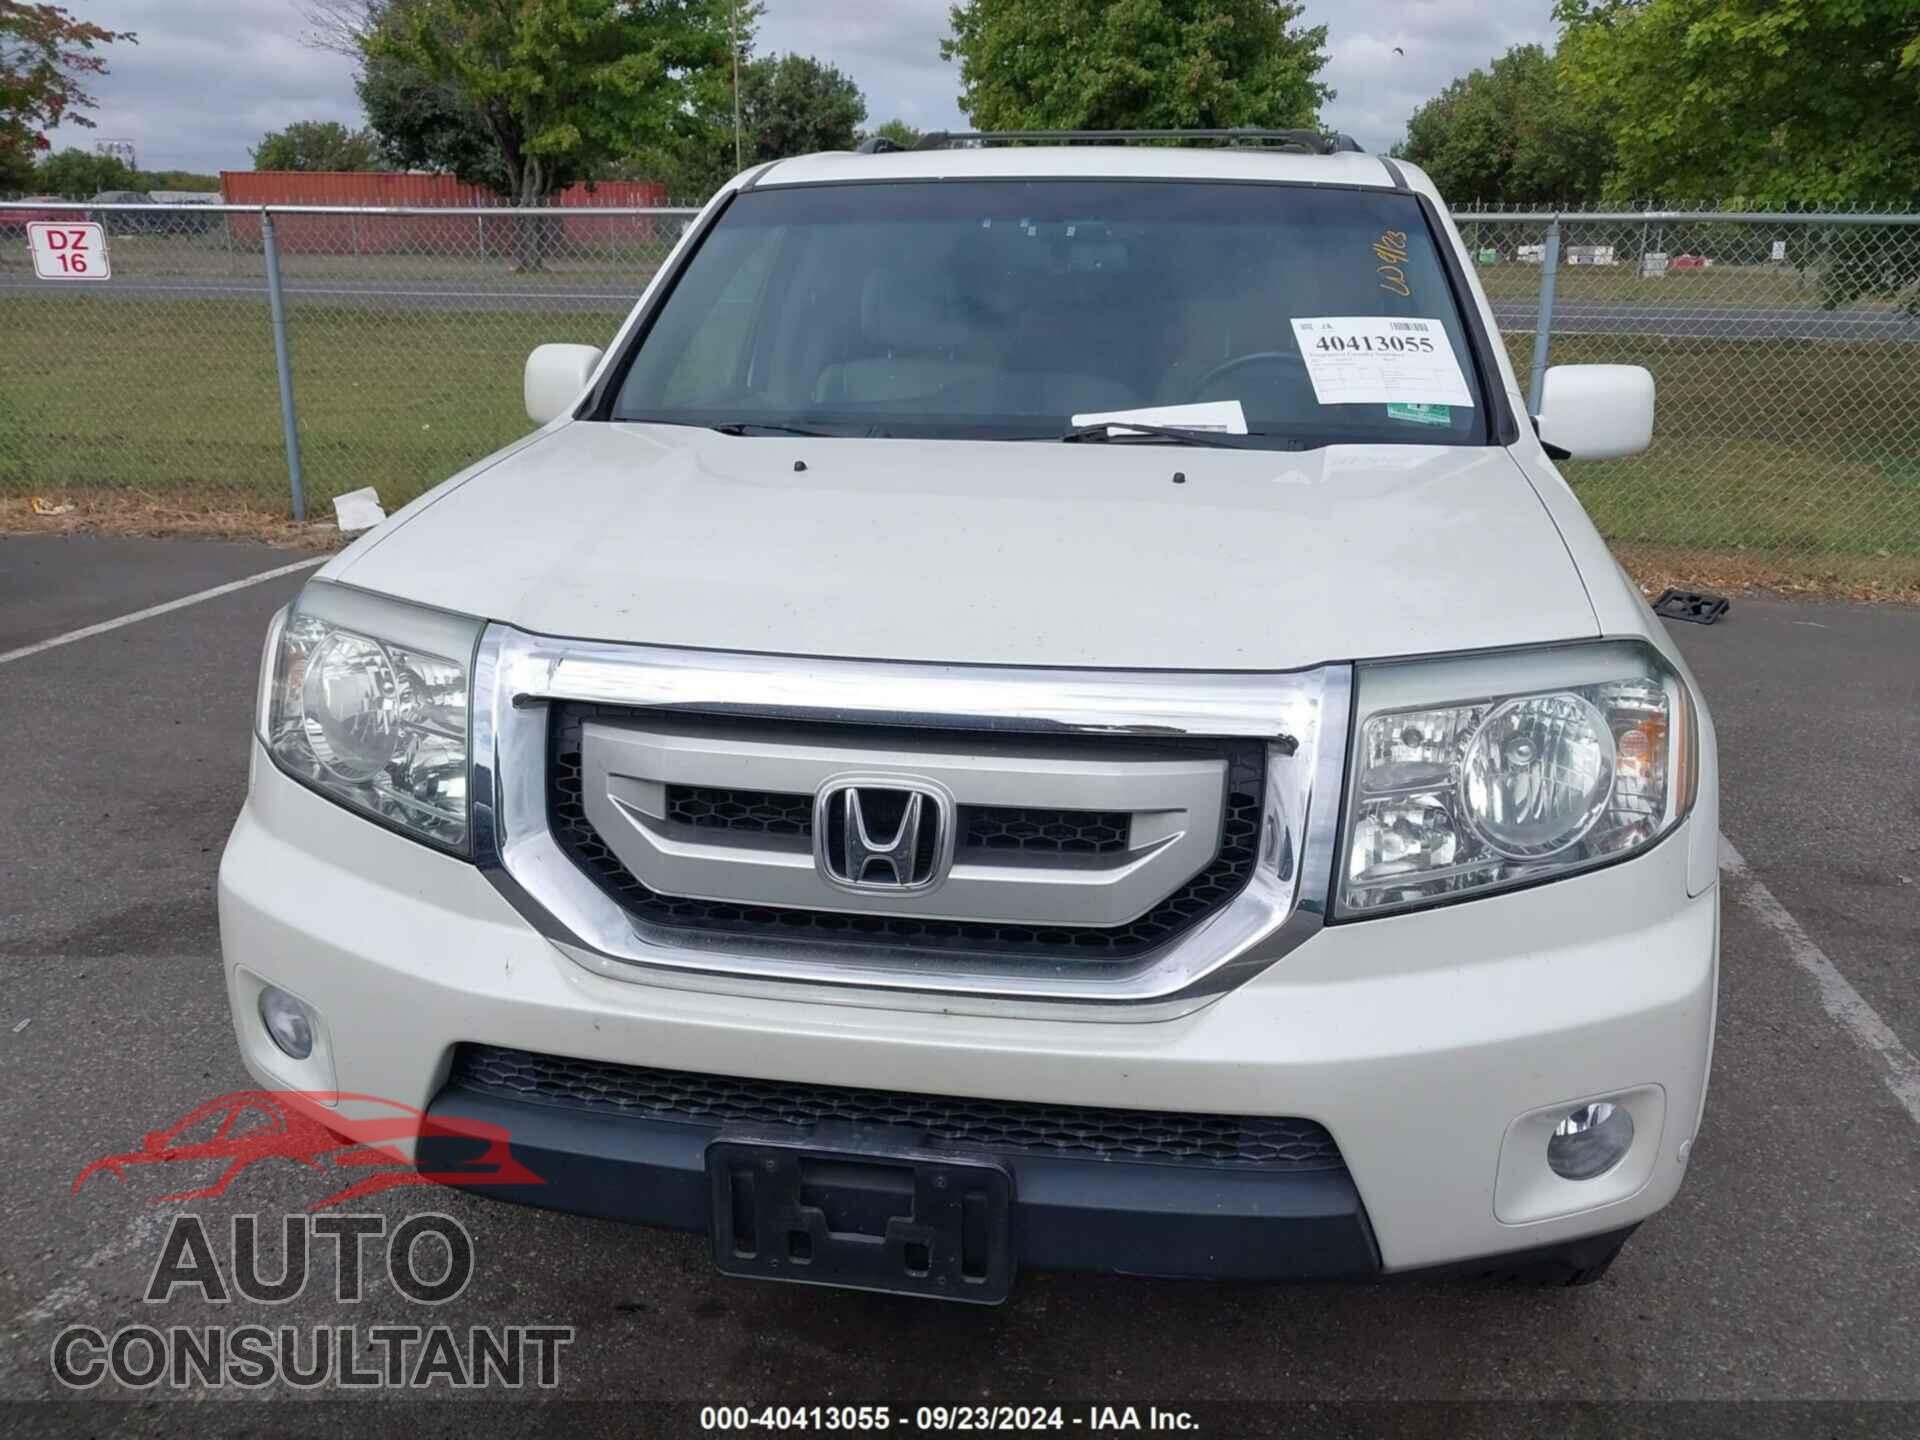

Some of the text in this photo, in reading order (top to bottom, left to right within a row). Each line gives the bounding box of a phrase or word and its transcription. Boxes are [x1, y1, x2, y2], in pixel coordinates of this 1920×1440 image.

[46, 230, 89, 250] DZ
[56, 253, 88, 273] 16
[1315, 335, 1434, 353] 40413055
